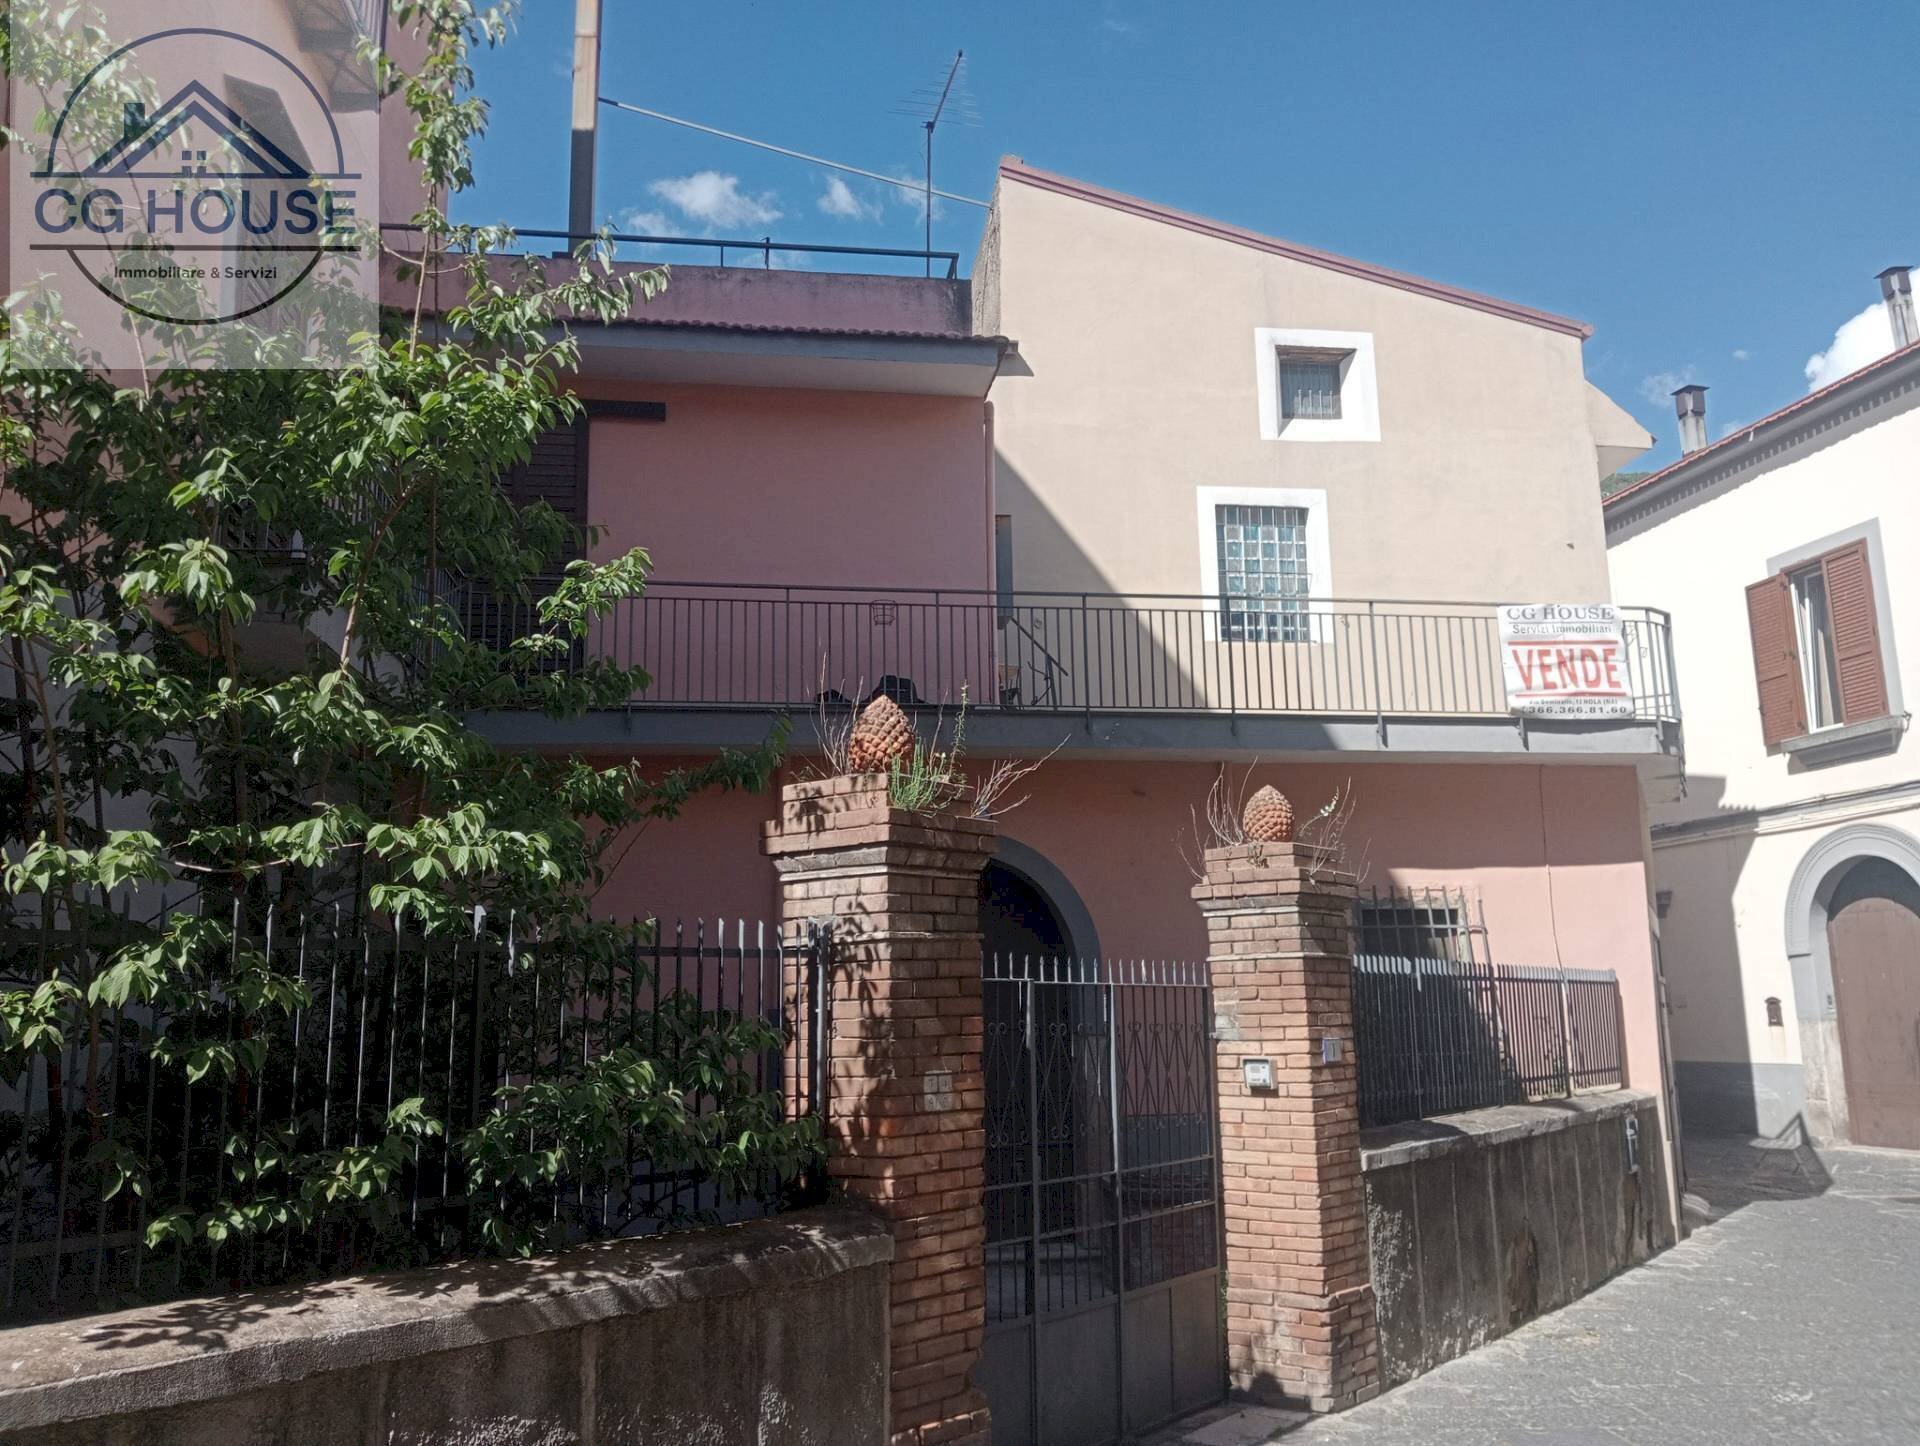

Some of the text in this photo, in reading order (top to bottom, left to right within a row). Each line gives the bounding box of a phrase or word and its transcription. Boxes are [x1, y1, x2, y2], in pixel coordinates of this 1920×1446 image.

[1507, 607, 1615, 620] CG HOUSE
[1512, 623, 1612, 635] Servizi Immobiliari
[1511, 648, 1622, 690] VENDE
[1528, 706, 1627, 714] 366.366.81.60
